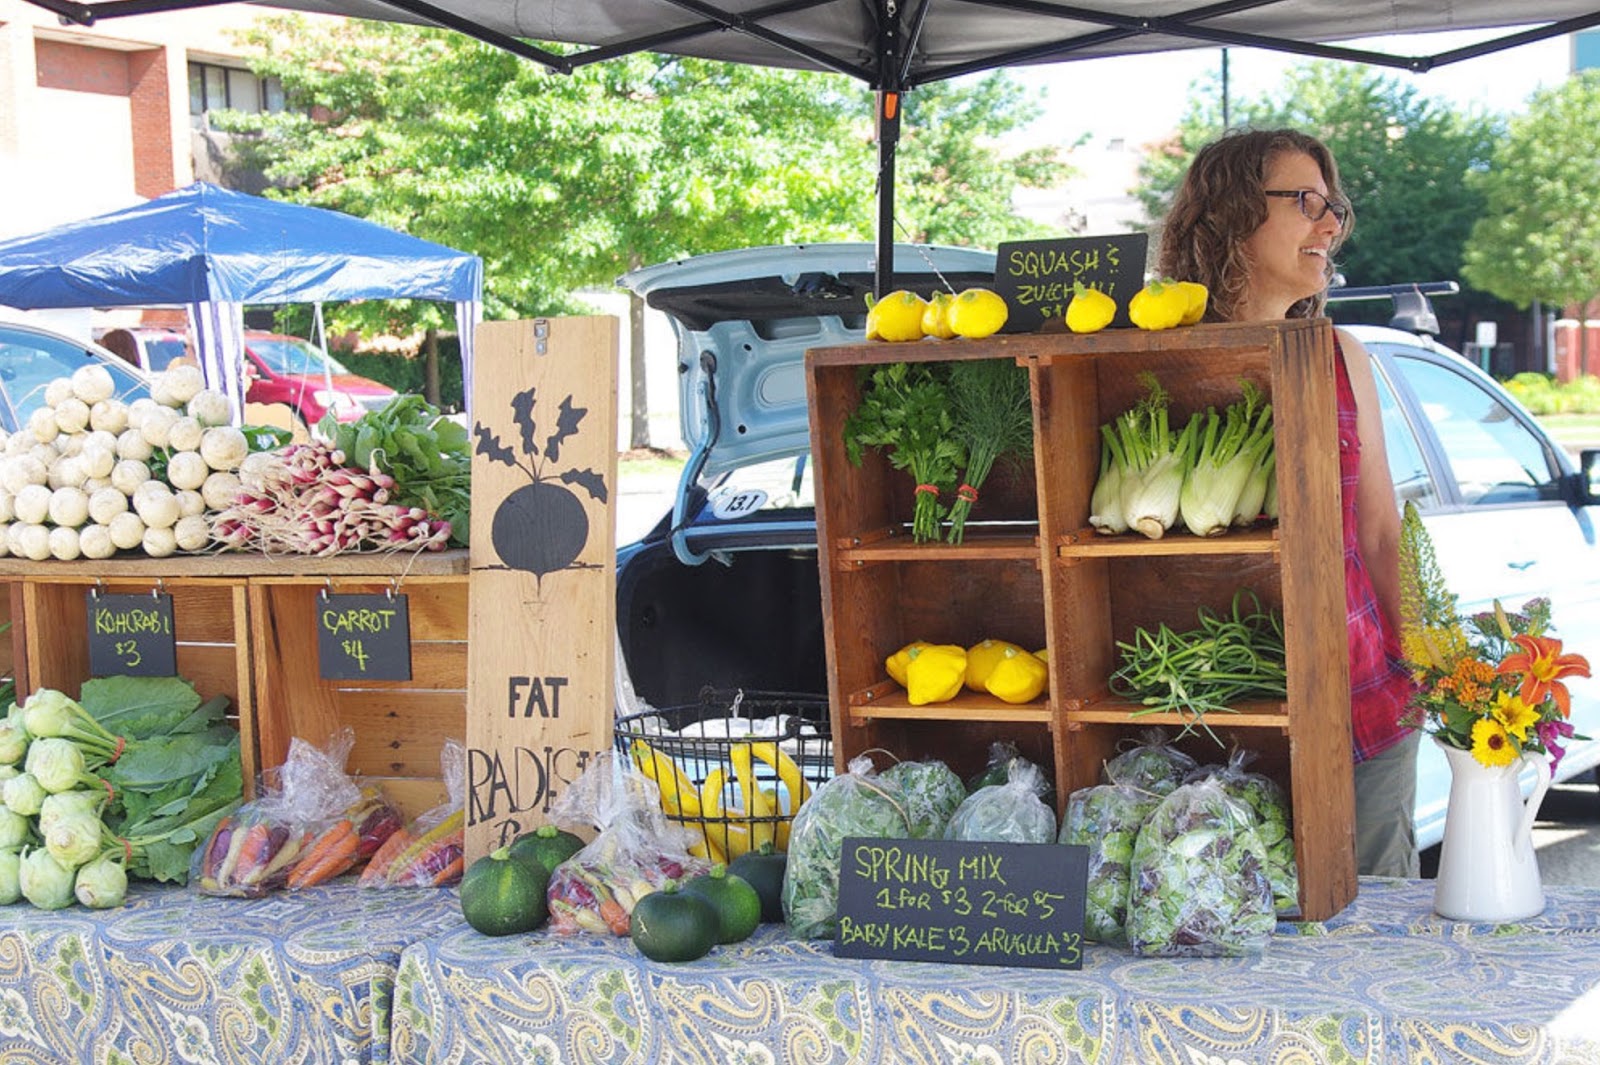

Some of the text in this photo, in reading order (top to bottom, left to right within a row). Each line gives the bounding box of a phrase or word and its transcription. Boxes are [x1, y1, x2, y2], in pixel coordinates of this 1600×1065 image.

[1008, 249, 1099, 278] SQUASH
[724, 494, 760, 512] 13.1
[95, 607, 170, 634] KOHLRABI
[323, 608, 396, 635] CARROT
[115, 640, 141, 667] $3
[341, 639, 369, 671] $4
[508, 676, 568, 718] FAT
[468, 746, 601, 826] RADIS
[855, 846, 1007, 889] SPRING MIX
[876, 888, 897, 909] 1
[941, 887, 972, 915] $3
[981, 890, 998, 918] 2
[1032, 889, 1065, 919] $5
[839, 916, 1082, 964] BABY KALE $3 ARUGULA $3
